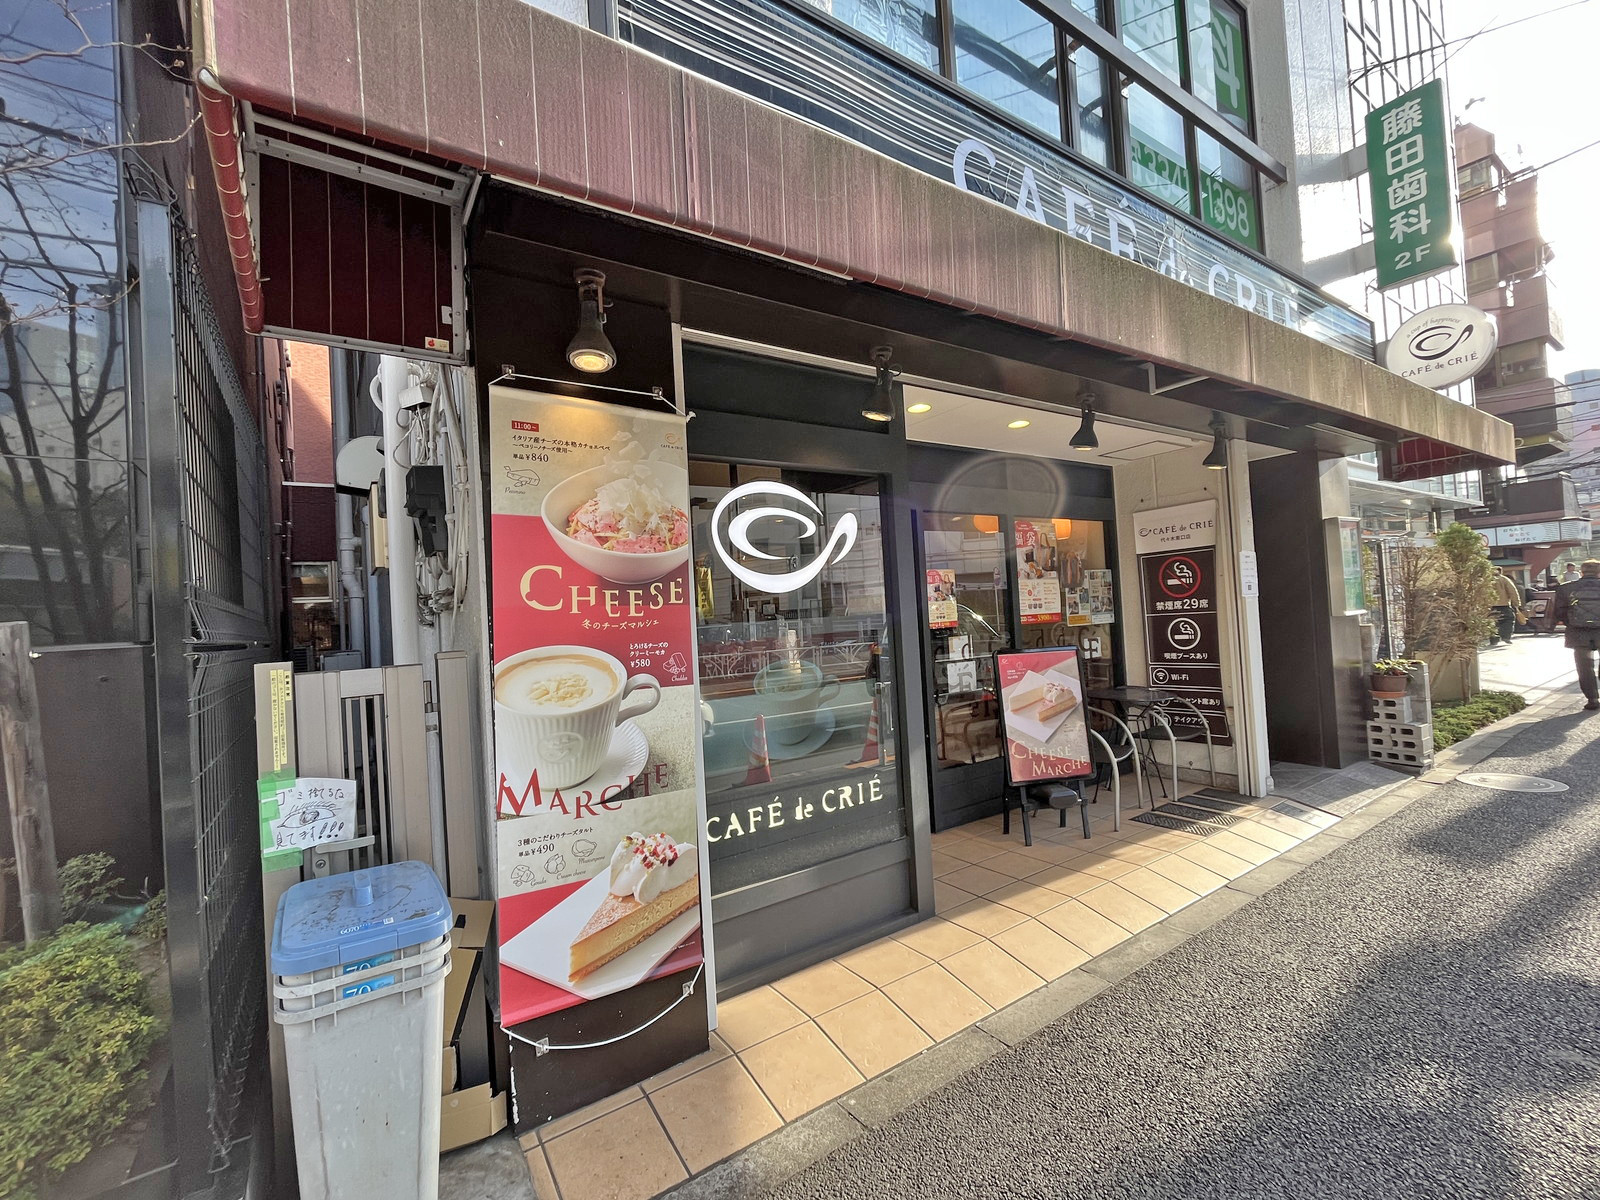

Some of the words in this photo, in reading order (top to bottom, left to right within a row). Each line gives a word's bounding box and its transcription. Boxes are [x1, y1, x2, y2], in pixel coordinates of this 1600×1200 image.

[1381, 97, 1432, 245] 藤田歯科
[1205, 176, 1250, 239] 1398
[1394, 242, 1432, 271] 2F
[1401, 364, 1432, 378] CAFÉ
[1434, 362, 1445, 370] de
[1447, 351, 1479, 367] CRIÉ
[519, 564, 685, 618] CHEESE
[1155, 598, 1210, 611] 禁煙席29席
[581, 618, 660, 631] 冬のチーズマルシェ
[629, 641, 669, 650] とろけるチーズの
[630, 658, 651, 668] ¥580
[1170, 673, 1190, 681] Wi-Fi
[706, 795, 785, 843] CAFÉ
[794, 796, 815, 820] de
[821, 773, 884, 813] CRIÉ
[517, 826, 594, 847] 3種のこだわりチーズタルト
